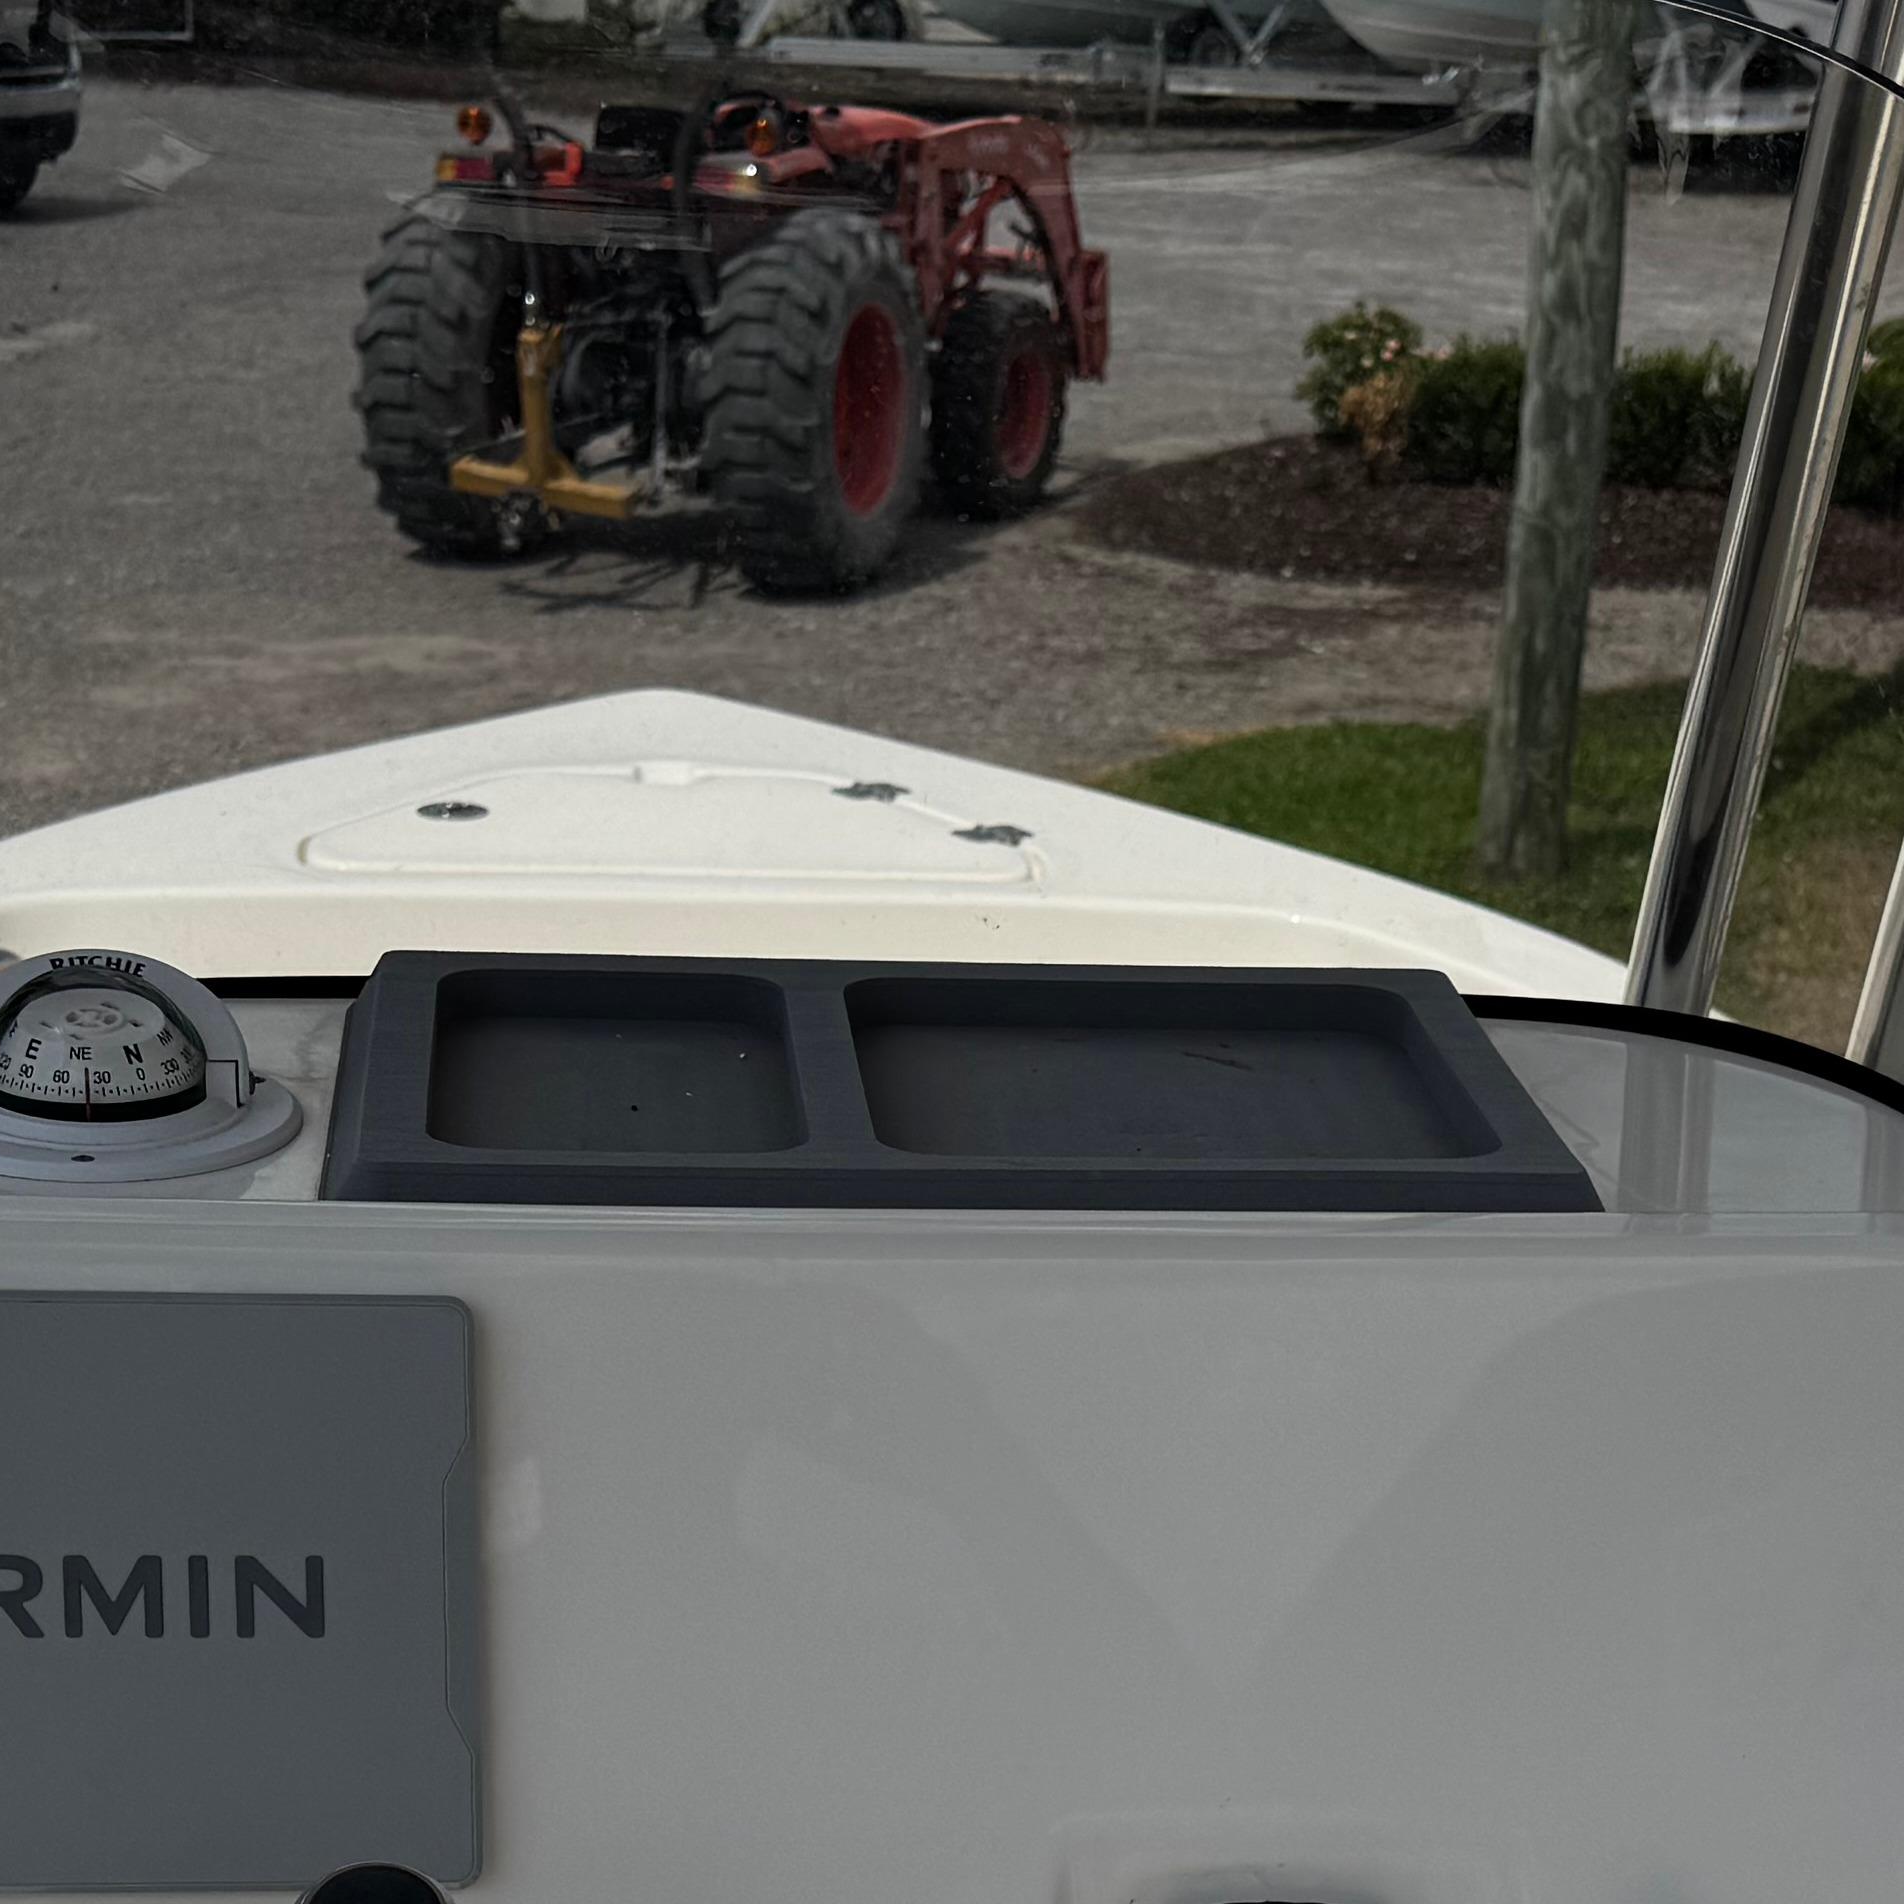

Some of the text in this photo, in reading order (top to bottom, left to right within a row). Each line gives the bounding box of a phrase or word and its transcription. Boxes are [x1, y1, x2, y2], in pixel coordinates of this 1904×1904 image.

[49, 955, 146, 978] RITCHIE
[25, 1038, 42, 1060] E
[69, 1046, 93, 1061] NE
[122, 1043, 143, 1065] N
[53, 1069, 71, 1084] 60
[93, 1070, 111, 1085] 30
[136, 1067, 146, 1081] 0
